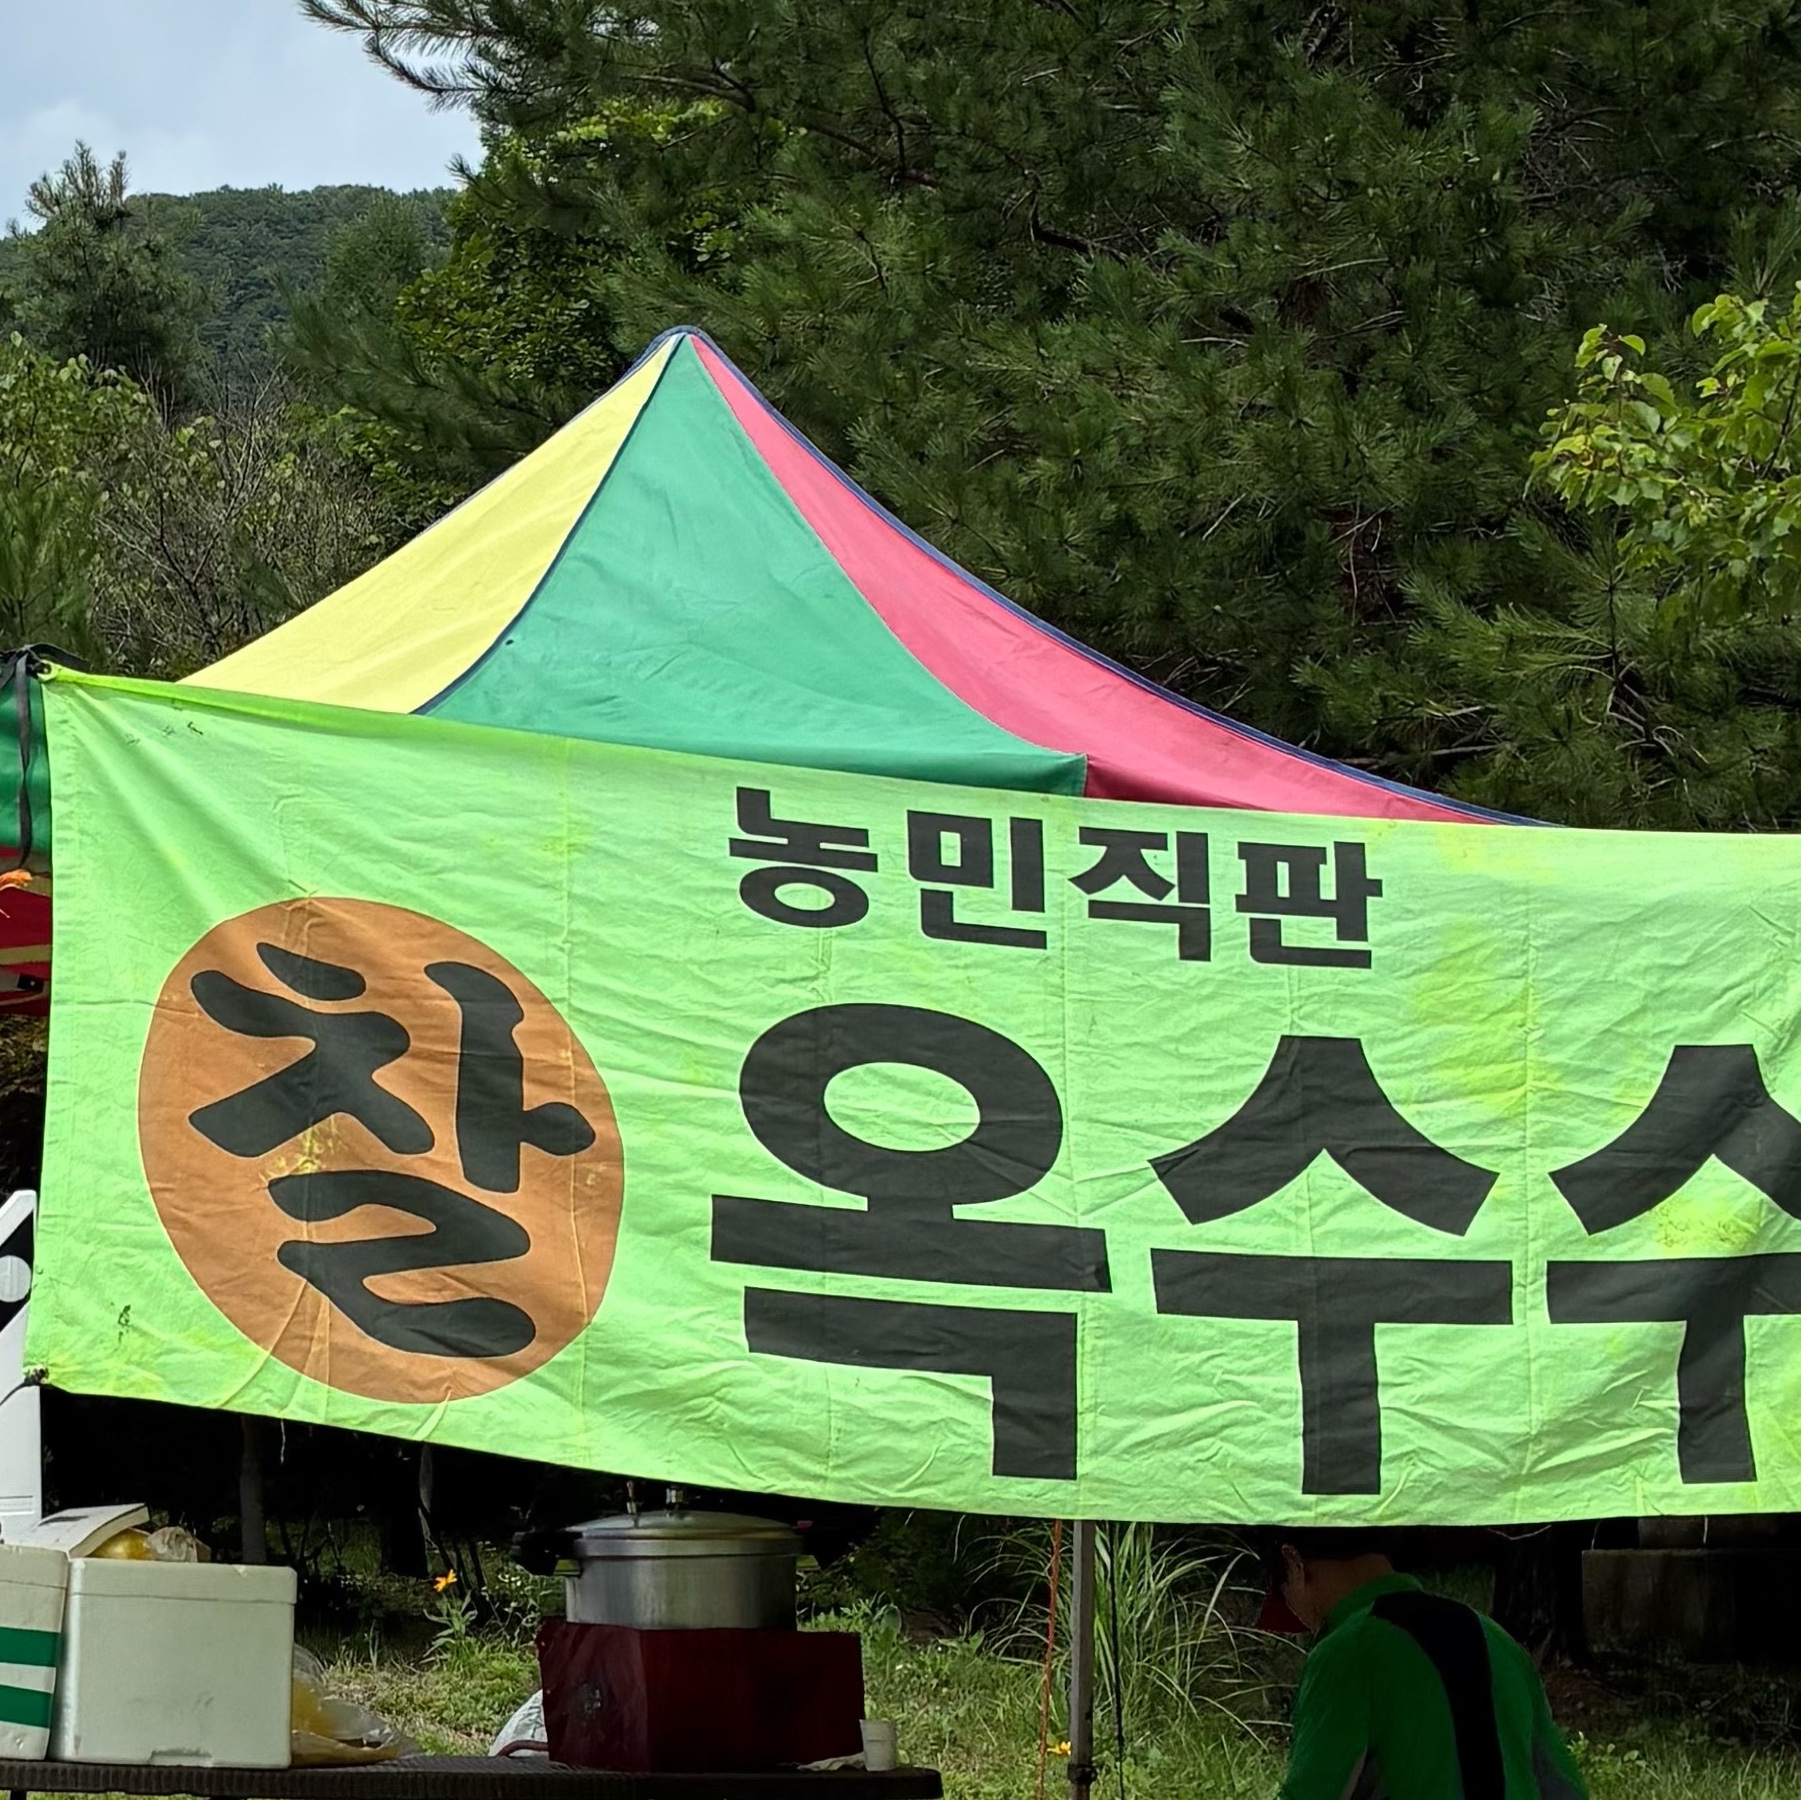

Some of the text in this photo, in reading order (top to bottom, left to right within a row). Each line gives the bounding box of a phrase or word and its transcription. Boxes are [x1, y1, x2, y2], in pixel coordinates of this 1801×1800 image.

[727, 785, 1384, 971] 농민직판
[187, 941, 1801, 1497] 찰 옥수수
